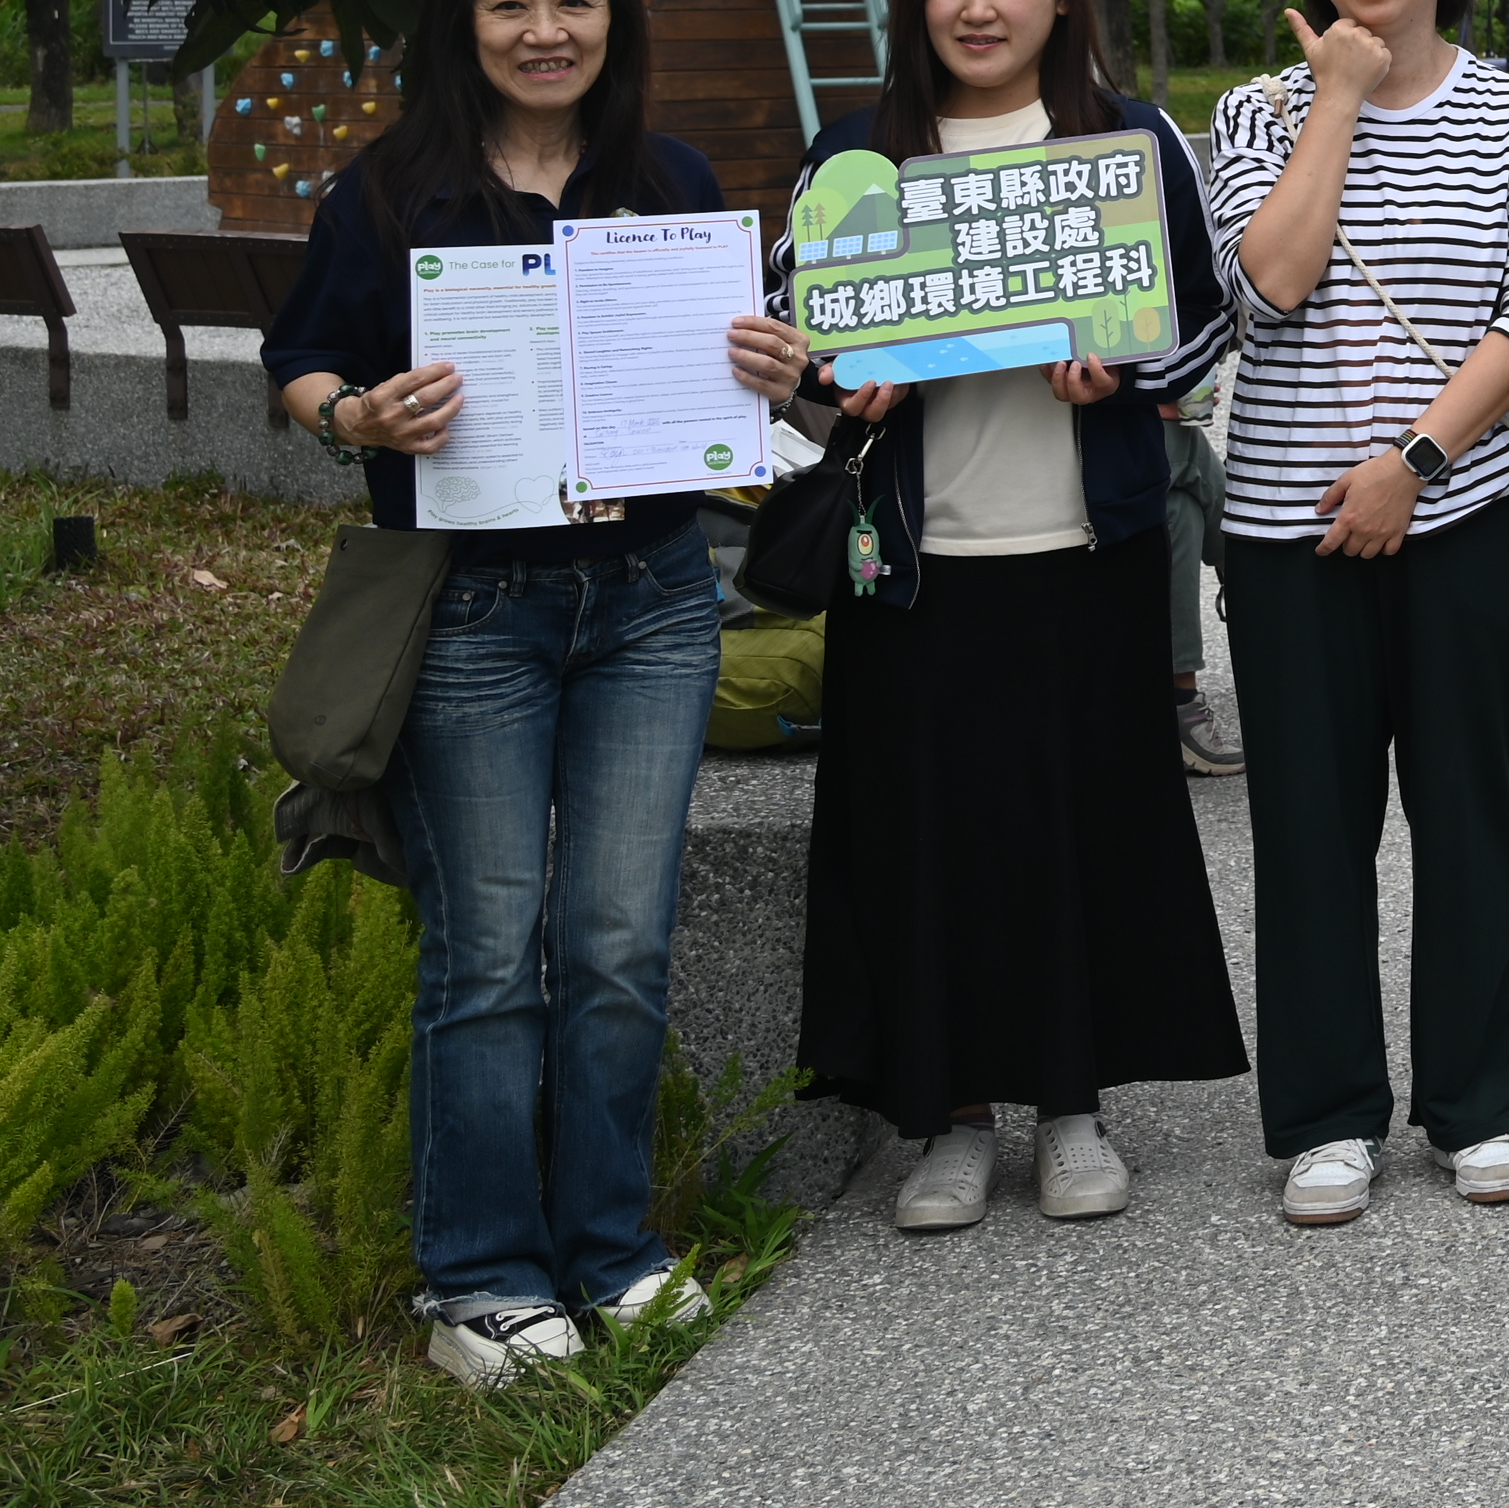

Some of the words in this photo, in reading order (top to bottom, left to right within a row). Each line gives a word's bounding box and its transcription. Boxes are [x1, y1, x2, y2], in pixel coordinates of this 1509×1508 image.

[900, 153, 1142, 224] 臺東縣政府
[606, 231, 657, 244] Licence
[661, 228, 677, 241] To
[681, 226, 712, 243] Play
[954, 206, 1100, 263] 建設處
[417, 260, 441, 271] play
[448, 261, 469, 270] The
[470, 260, 499, 270] Case
[501, 259, 515, 268] for
[521, 253, 556, 277] PL
[807, 244, 1153, 330] 城鄉環境工程科
[706, 451, 731, 462] play
